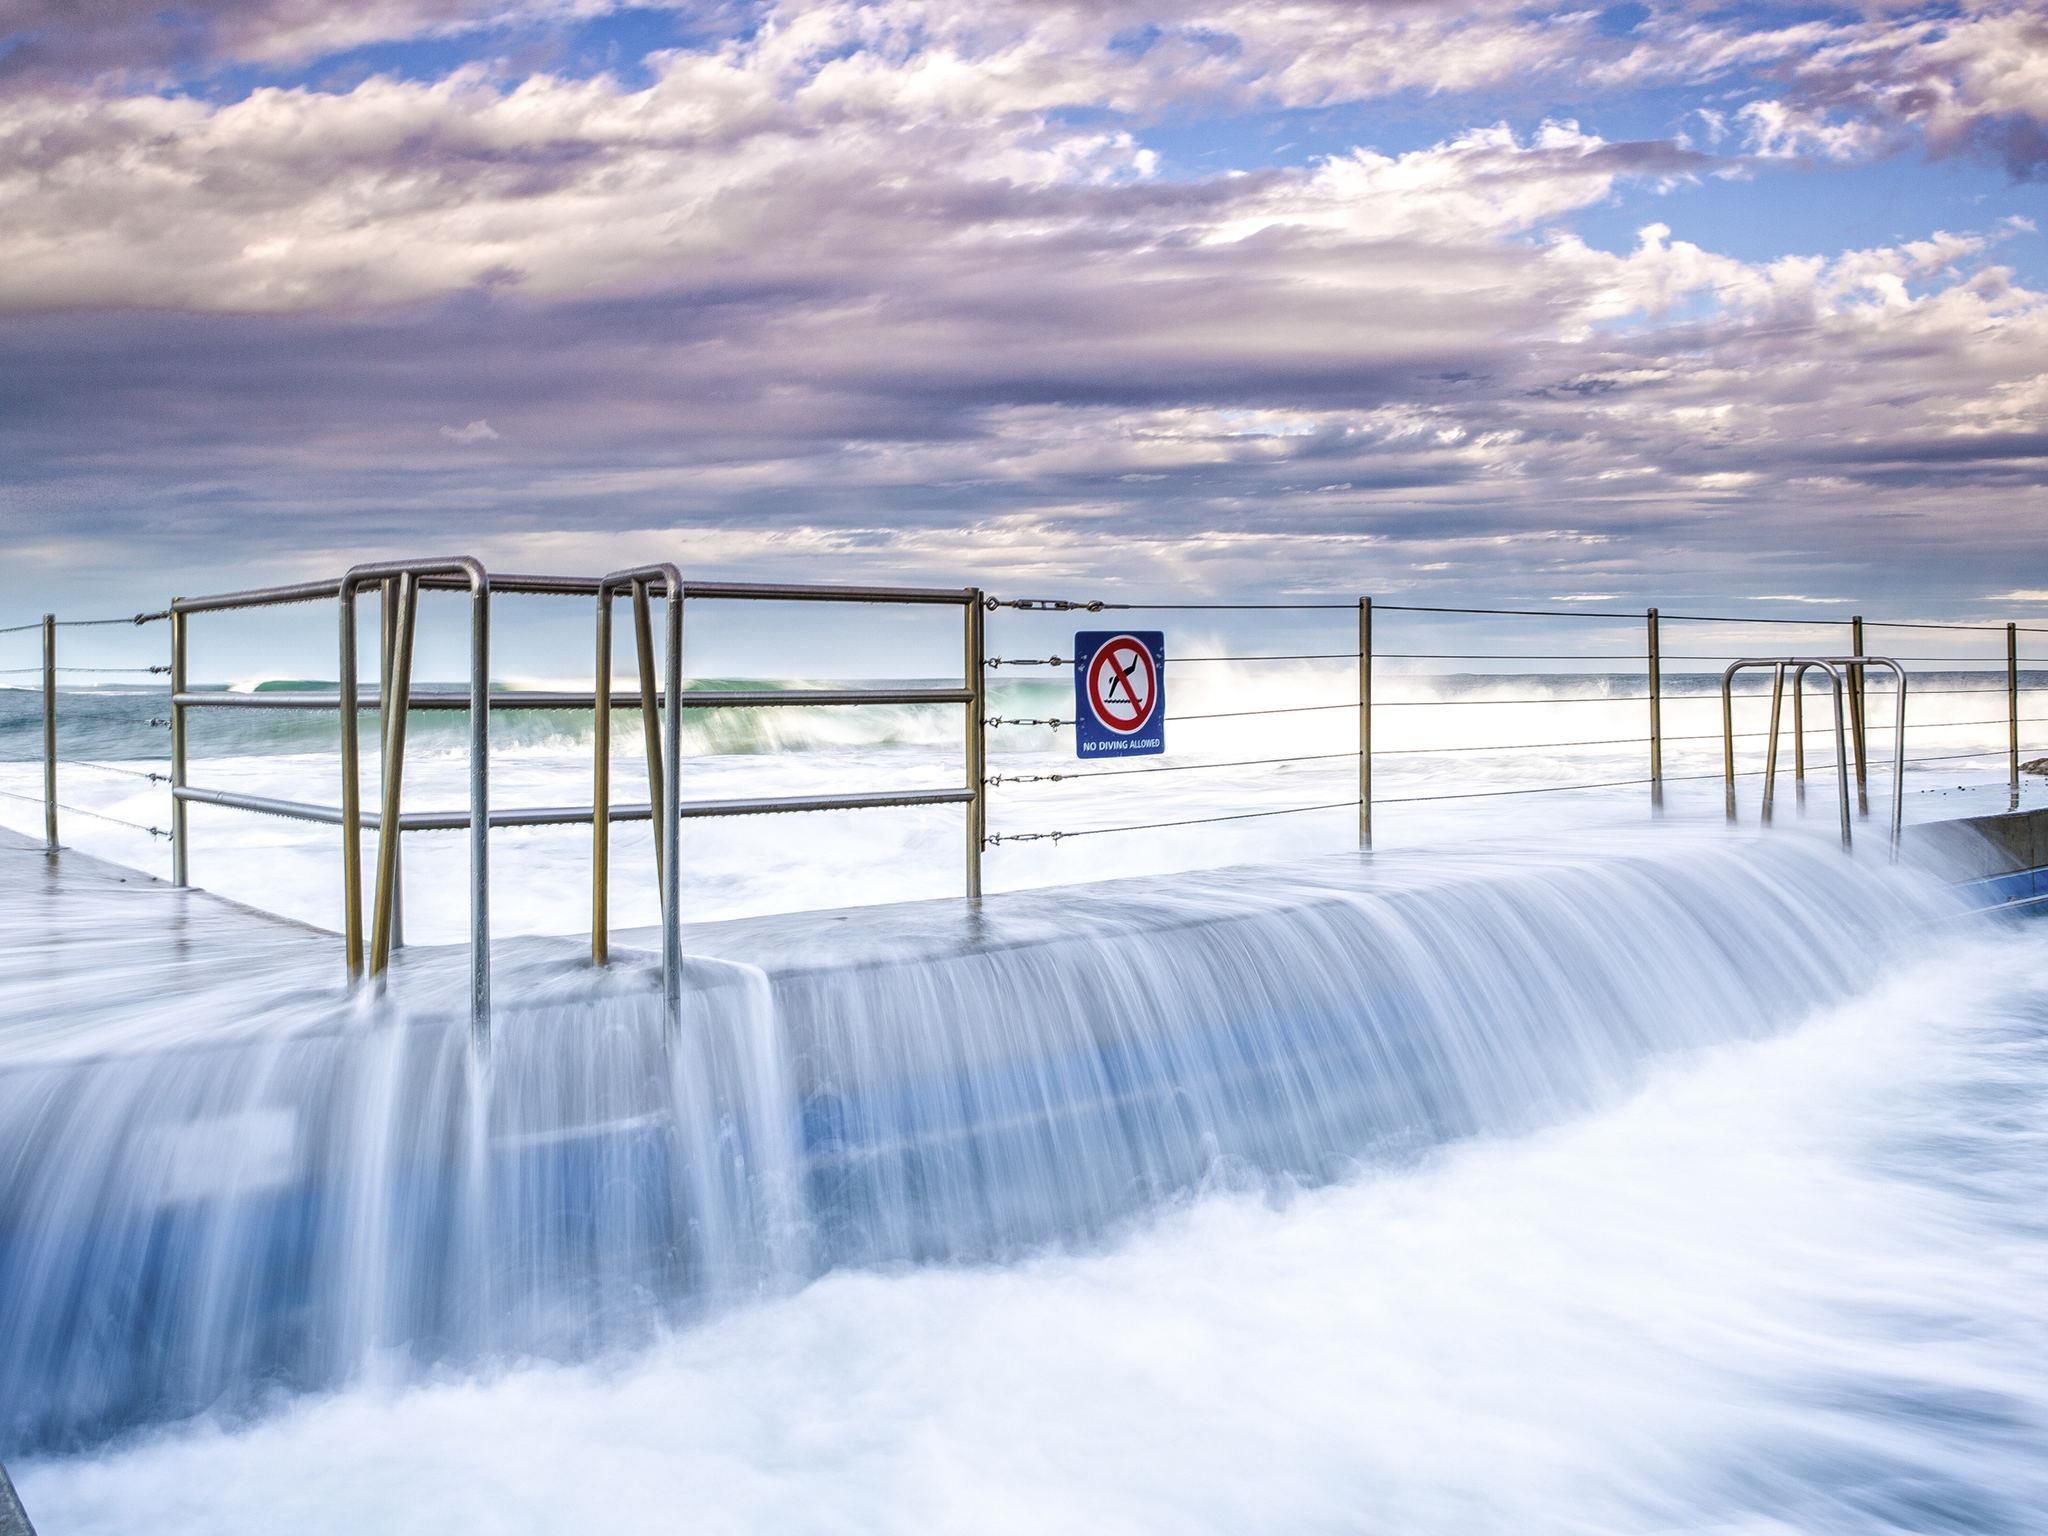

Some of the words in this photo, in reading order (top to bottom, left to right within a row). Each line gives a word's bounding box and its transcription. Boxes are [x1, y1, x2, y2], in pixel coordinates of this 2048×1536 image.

[1083, 742, 1097, 751] NO
[1099, 740, 1128, 751] DIVING
[1129, 738, 1160, 749] ALLOWED
